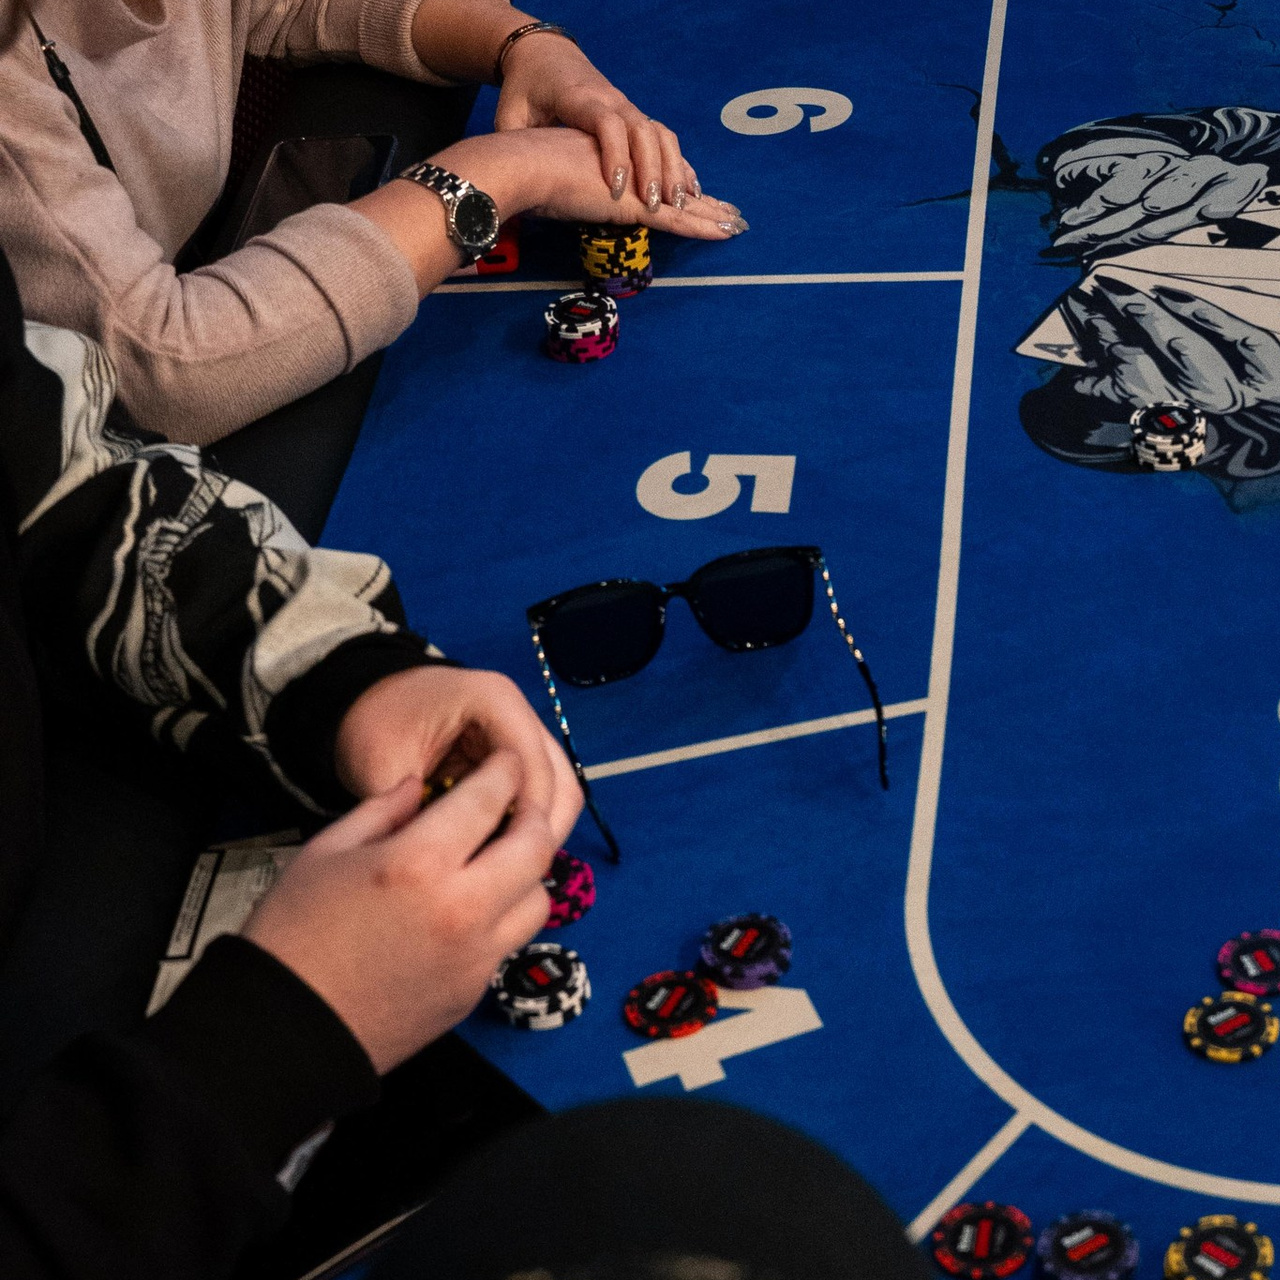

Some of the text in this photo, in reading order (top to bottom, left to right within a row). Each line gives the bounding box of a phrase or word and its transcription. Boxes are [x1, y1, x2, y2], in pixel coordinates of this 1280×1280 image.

[720, 86, 854, 136] 6
[1033, 342, 1076, 359] A
[636, 450, 797, 521] 5
